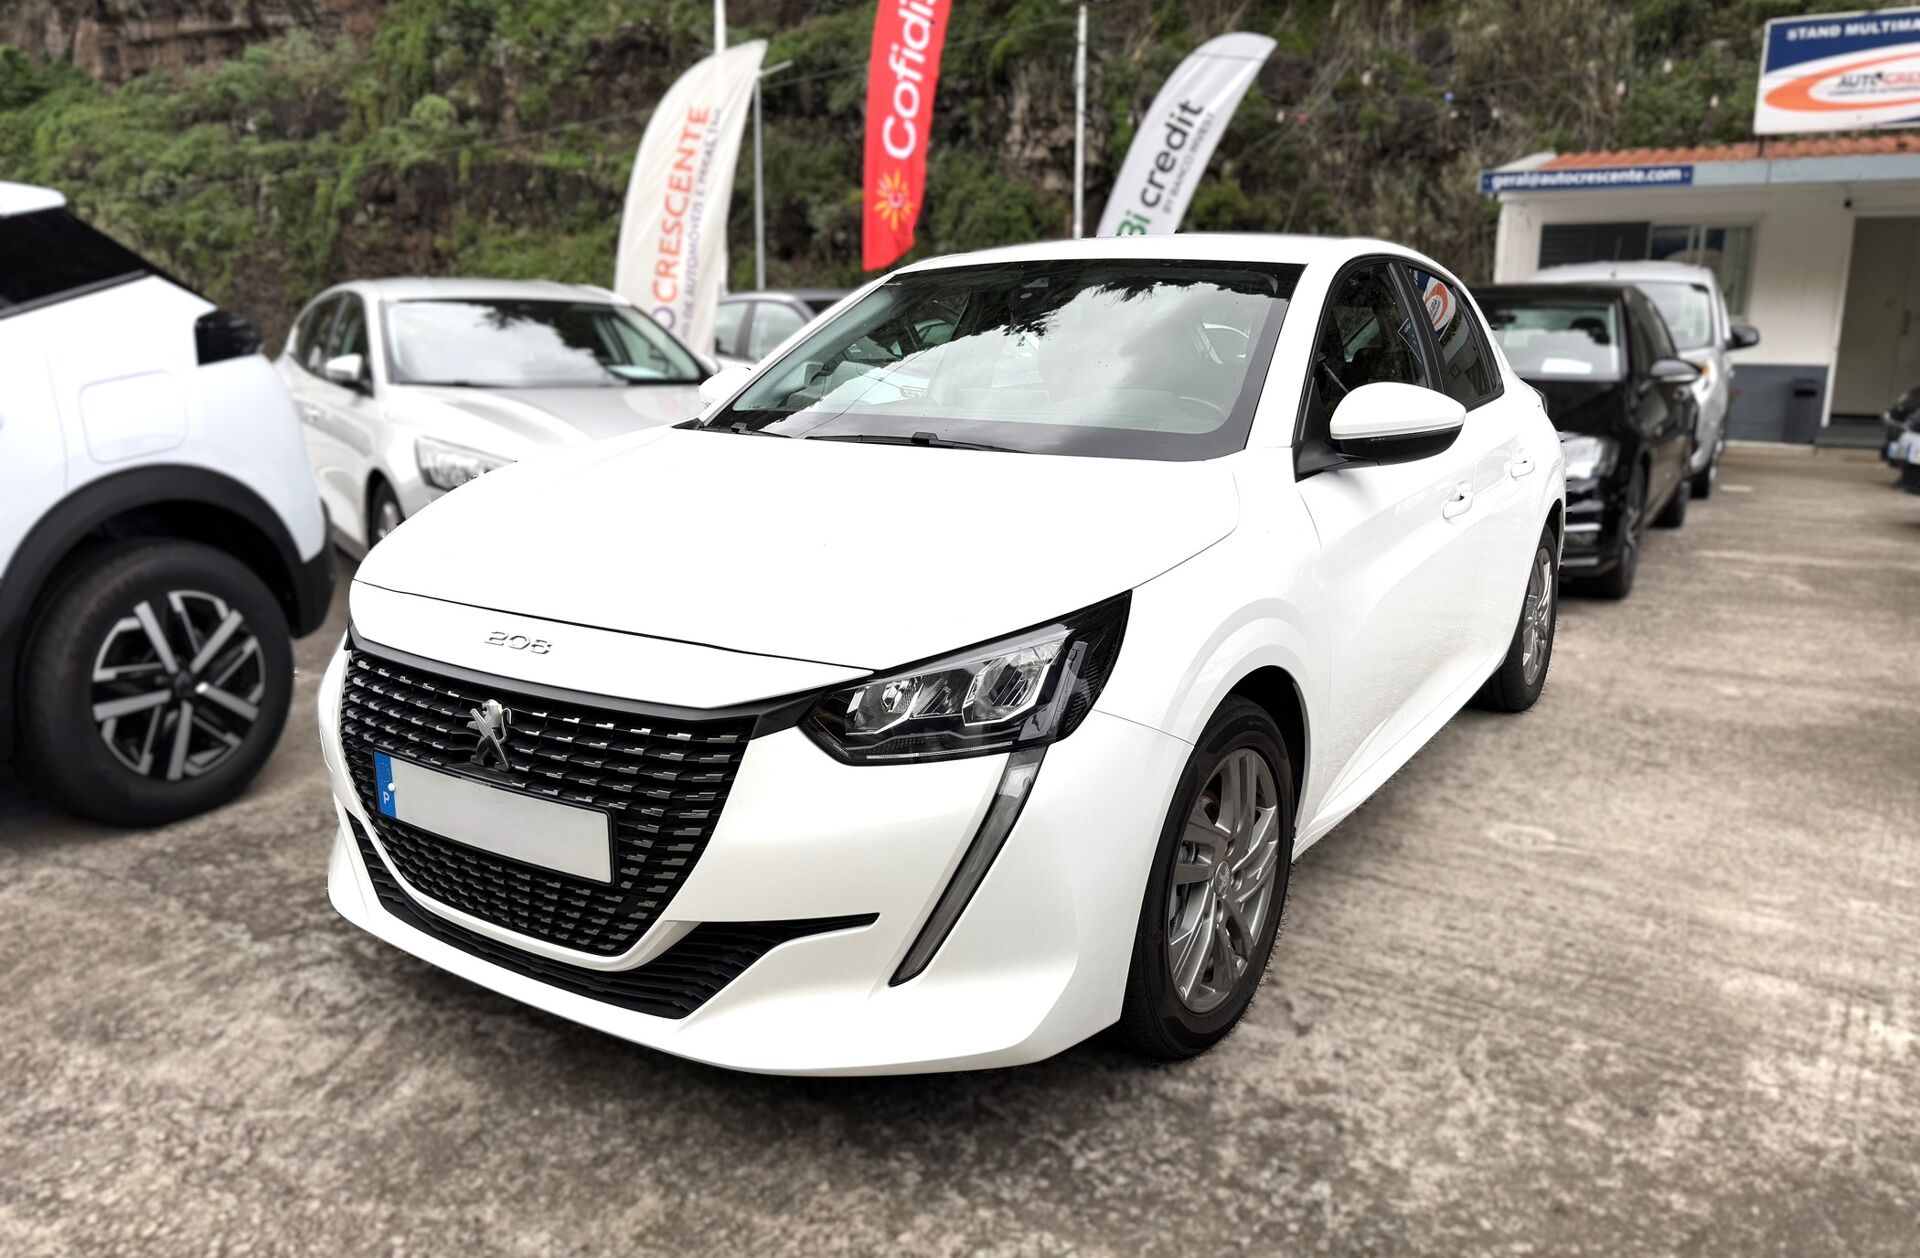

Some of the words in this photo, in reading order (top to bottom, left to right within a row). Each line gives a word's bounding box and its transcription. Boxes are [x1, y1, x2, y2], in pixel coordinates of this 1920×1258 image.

[1786, 24, 1842, 41] STAND
[1140, 100, 1204, 209] credit
[1491, 168, 1682, 191] geral@autocrescente.com
[484, 631, 552, 654] 208
[382, 791, 390, 805] P
